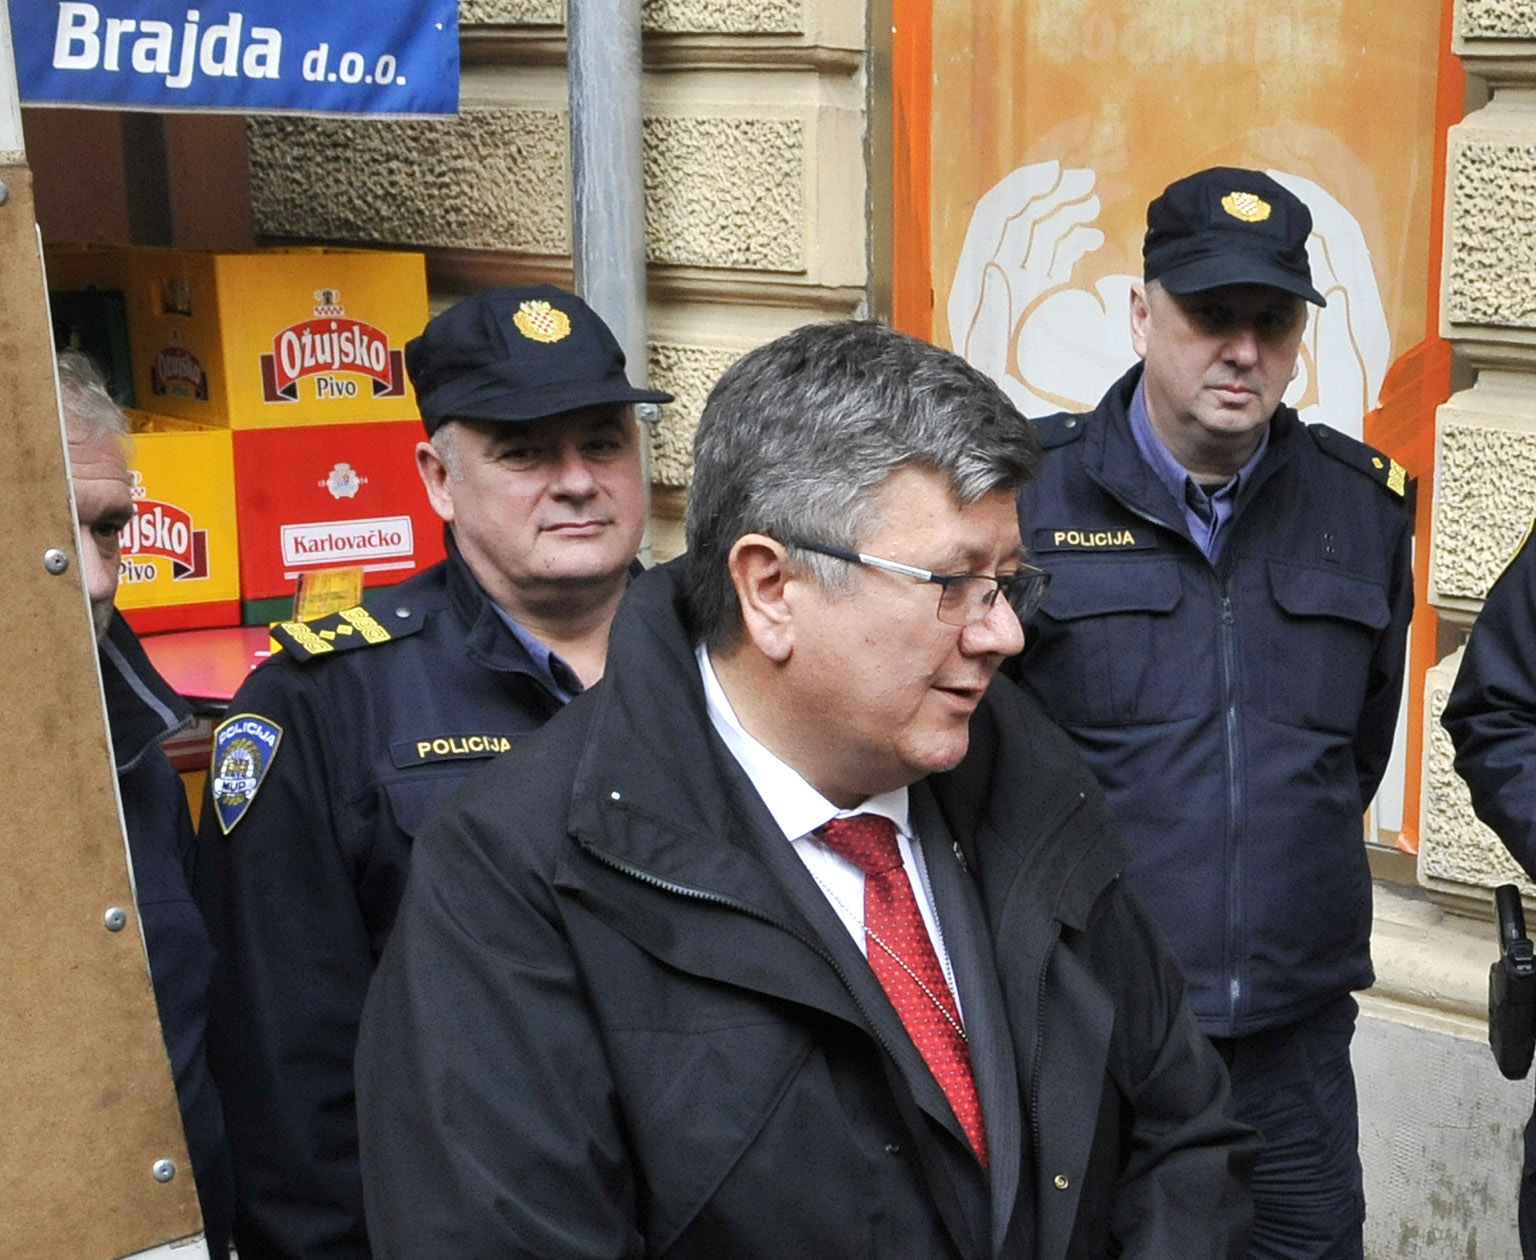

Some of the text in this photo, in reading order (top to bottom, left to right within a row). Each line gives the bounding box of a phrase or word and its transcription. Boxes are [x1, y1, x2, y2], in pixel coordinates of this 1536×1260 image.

[52, 2, 407, 89] Brajda d.o.o.
[280, 321, 386, 379] Ožujsko
[317, 377, 357, 398] Pivo
[119, 505, 189, 554] ujsko
[293, 528, 402, 554] Karlovačko
[1054, 530, 1135, 546] POLICIJA
[219, 722, 276, 747] POLICIJA
[417, 736, 511, 758] POLICIJA
